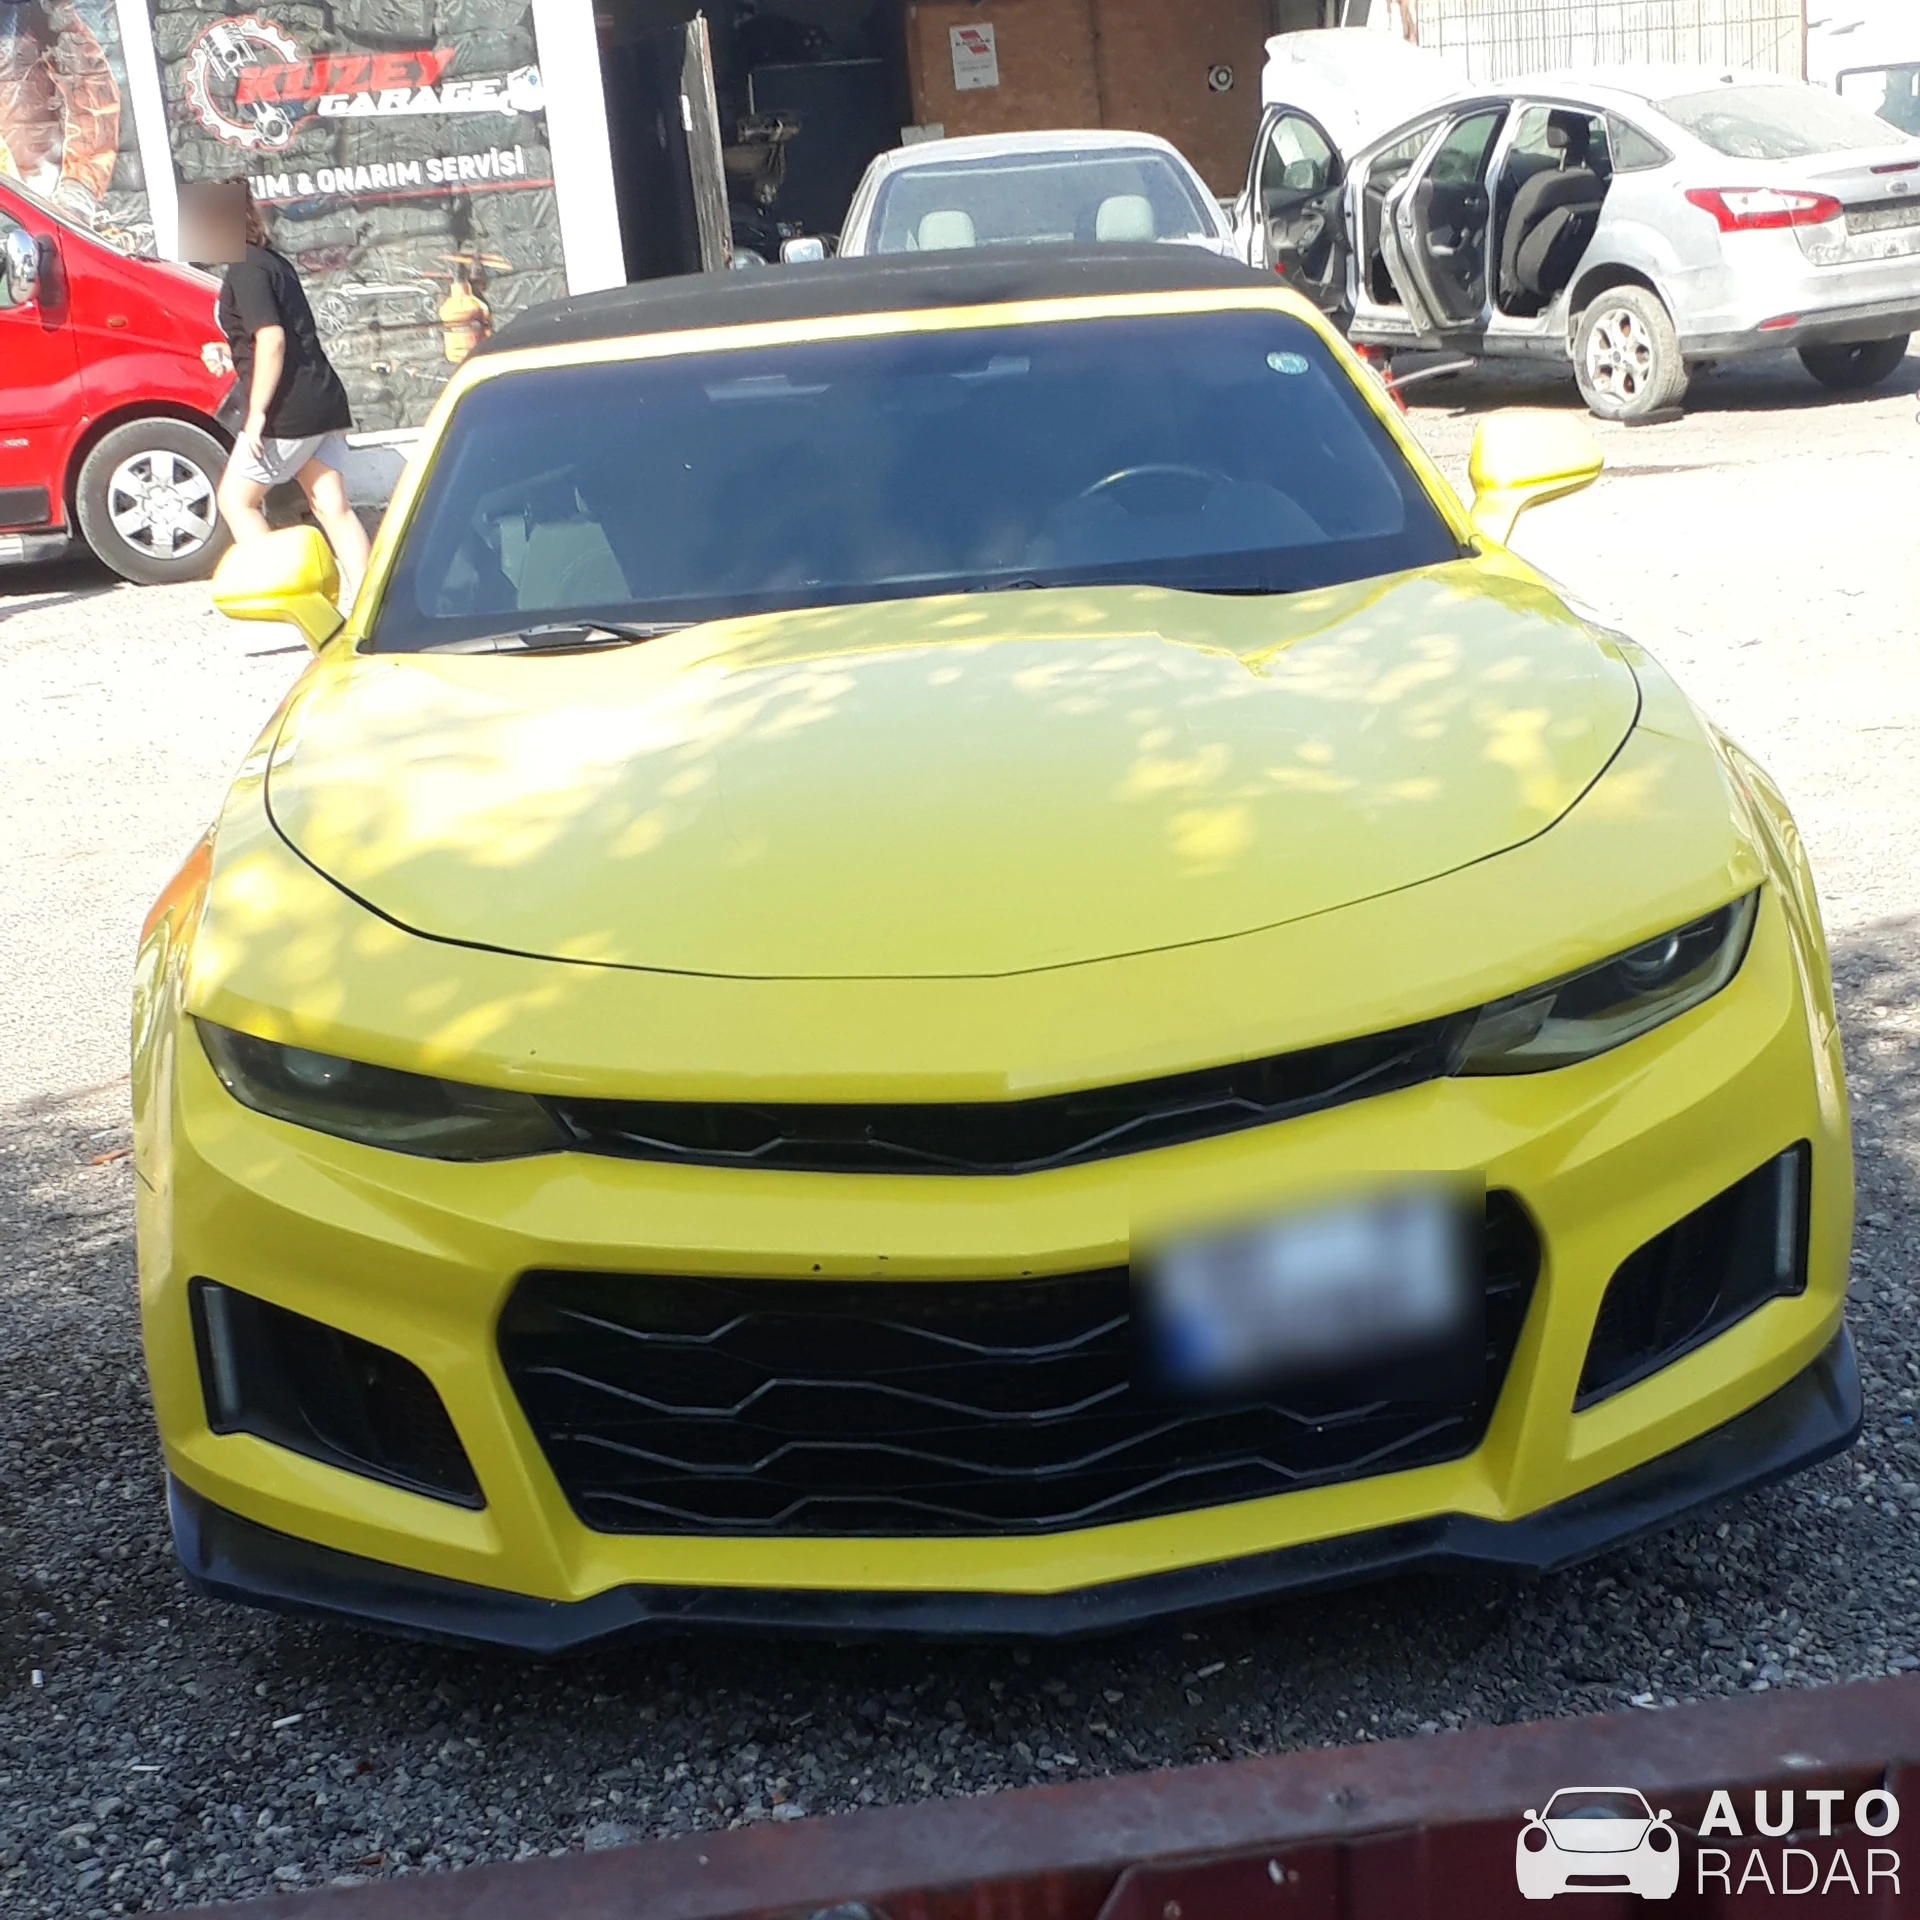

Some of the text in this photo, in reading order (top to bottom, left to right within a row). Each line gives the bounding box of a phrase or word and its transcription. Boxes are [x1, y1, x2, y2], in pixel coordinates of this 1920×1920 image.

[235, 47, 455, 104] KUZEY
[317, 79, 500, 117] GARAGE
[297, 172, 315, 195] &
[316, 160, 421, 193] ONARIM
[425, 144, 525, 183] SERVİSİ
